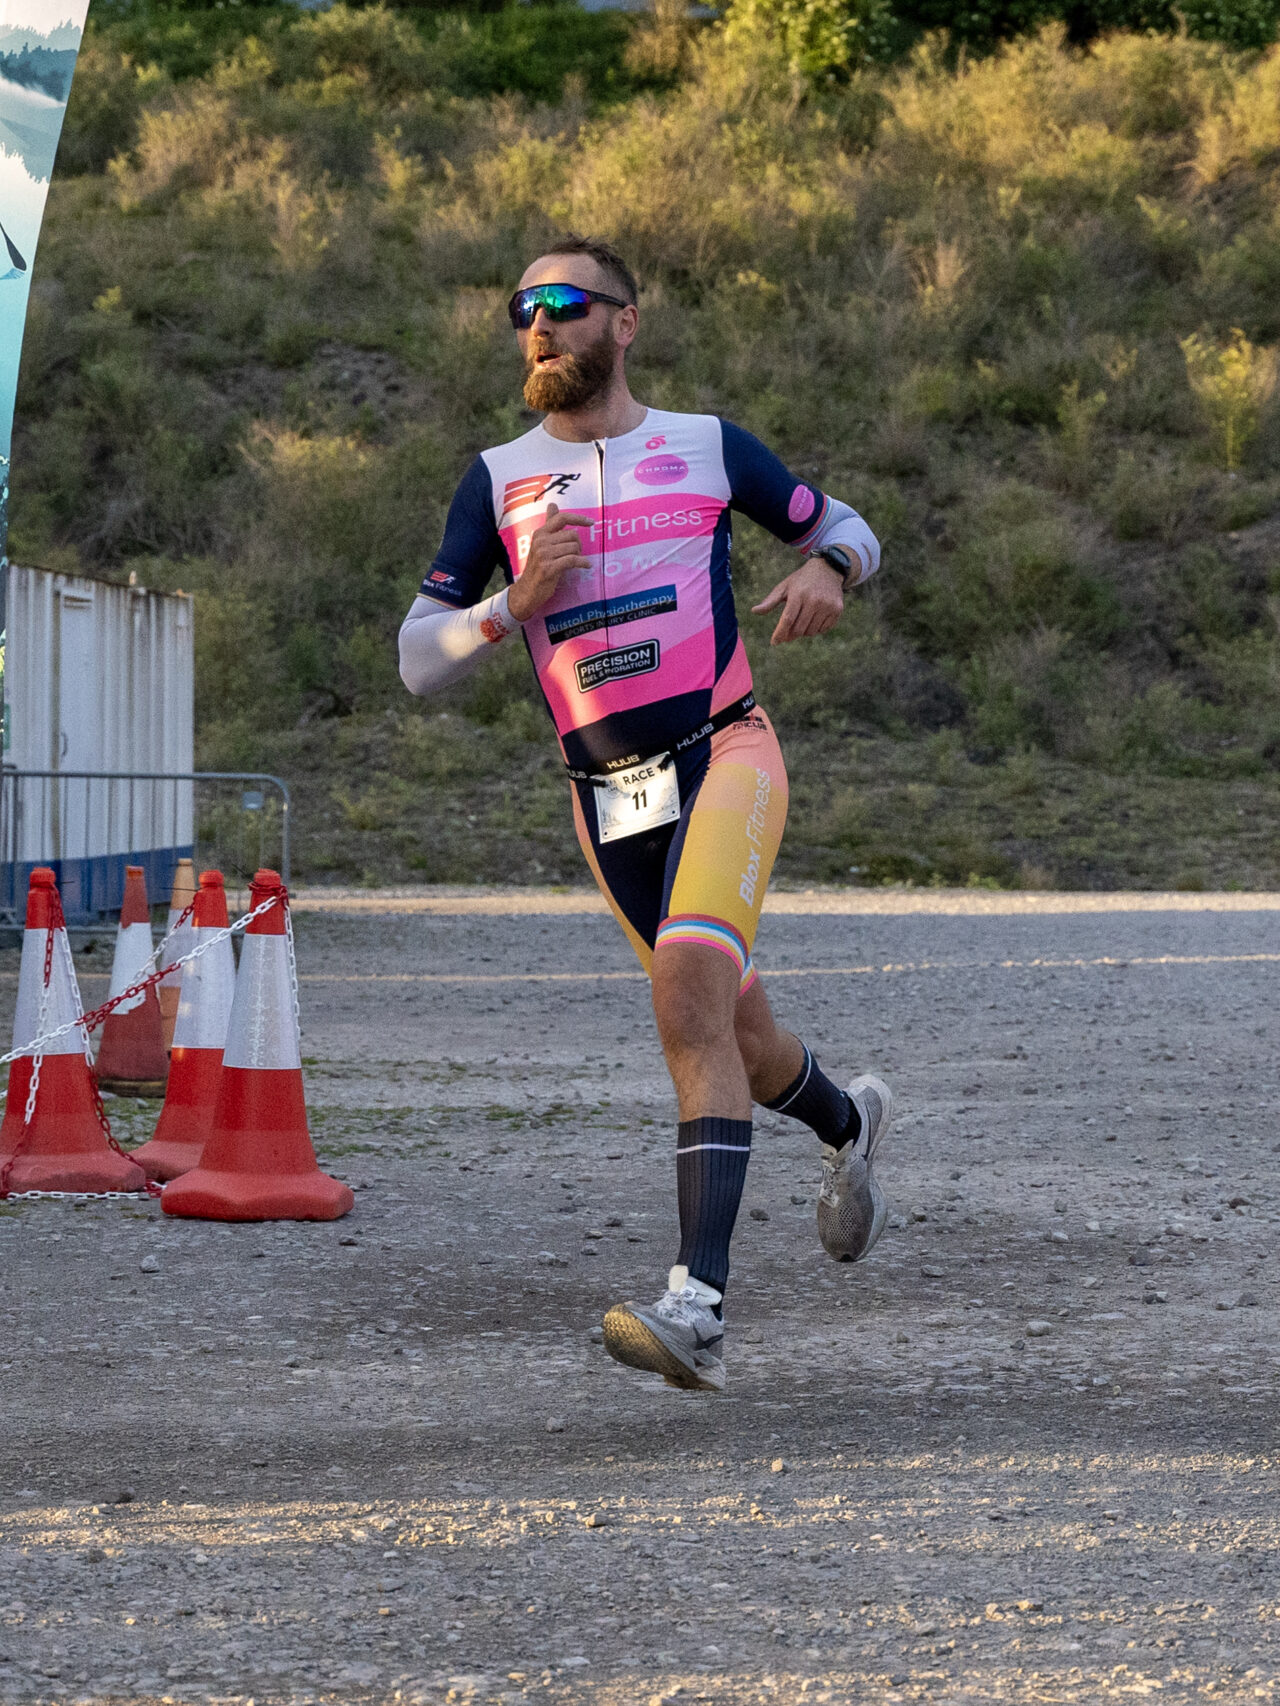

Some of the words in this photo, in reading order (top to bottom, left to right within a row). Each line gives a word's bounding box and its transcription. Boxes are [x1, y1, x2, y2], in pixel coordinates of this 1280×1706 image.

[637, 464, 686, 474] CHROMA
[589, 510, 702, 542] Fitness
[548, 613, 585, 634] Bristol
[563, 623, 596, 638] SPORTS
[596, 616, 625, 628] INURY
[626, 607, 657, 621] CLINIC
[580, 648, 651, 677] PRECISION
[582, 671, 598, 685] FUEL
[598, 670, 605, 678] &
[604, 658, 651, 675] HYDRATION
[676, 722, 715, 751] HUUB
[567, 770, 588, 779] UUB
[606, 754, 641, 770] HUUB
[622, 767, 656, 786] RACE
[632, 789, 648, 811] 11
[746, 768, 771, 848] Fitness
[739, 847, 761, 908] Blox
